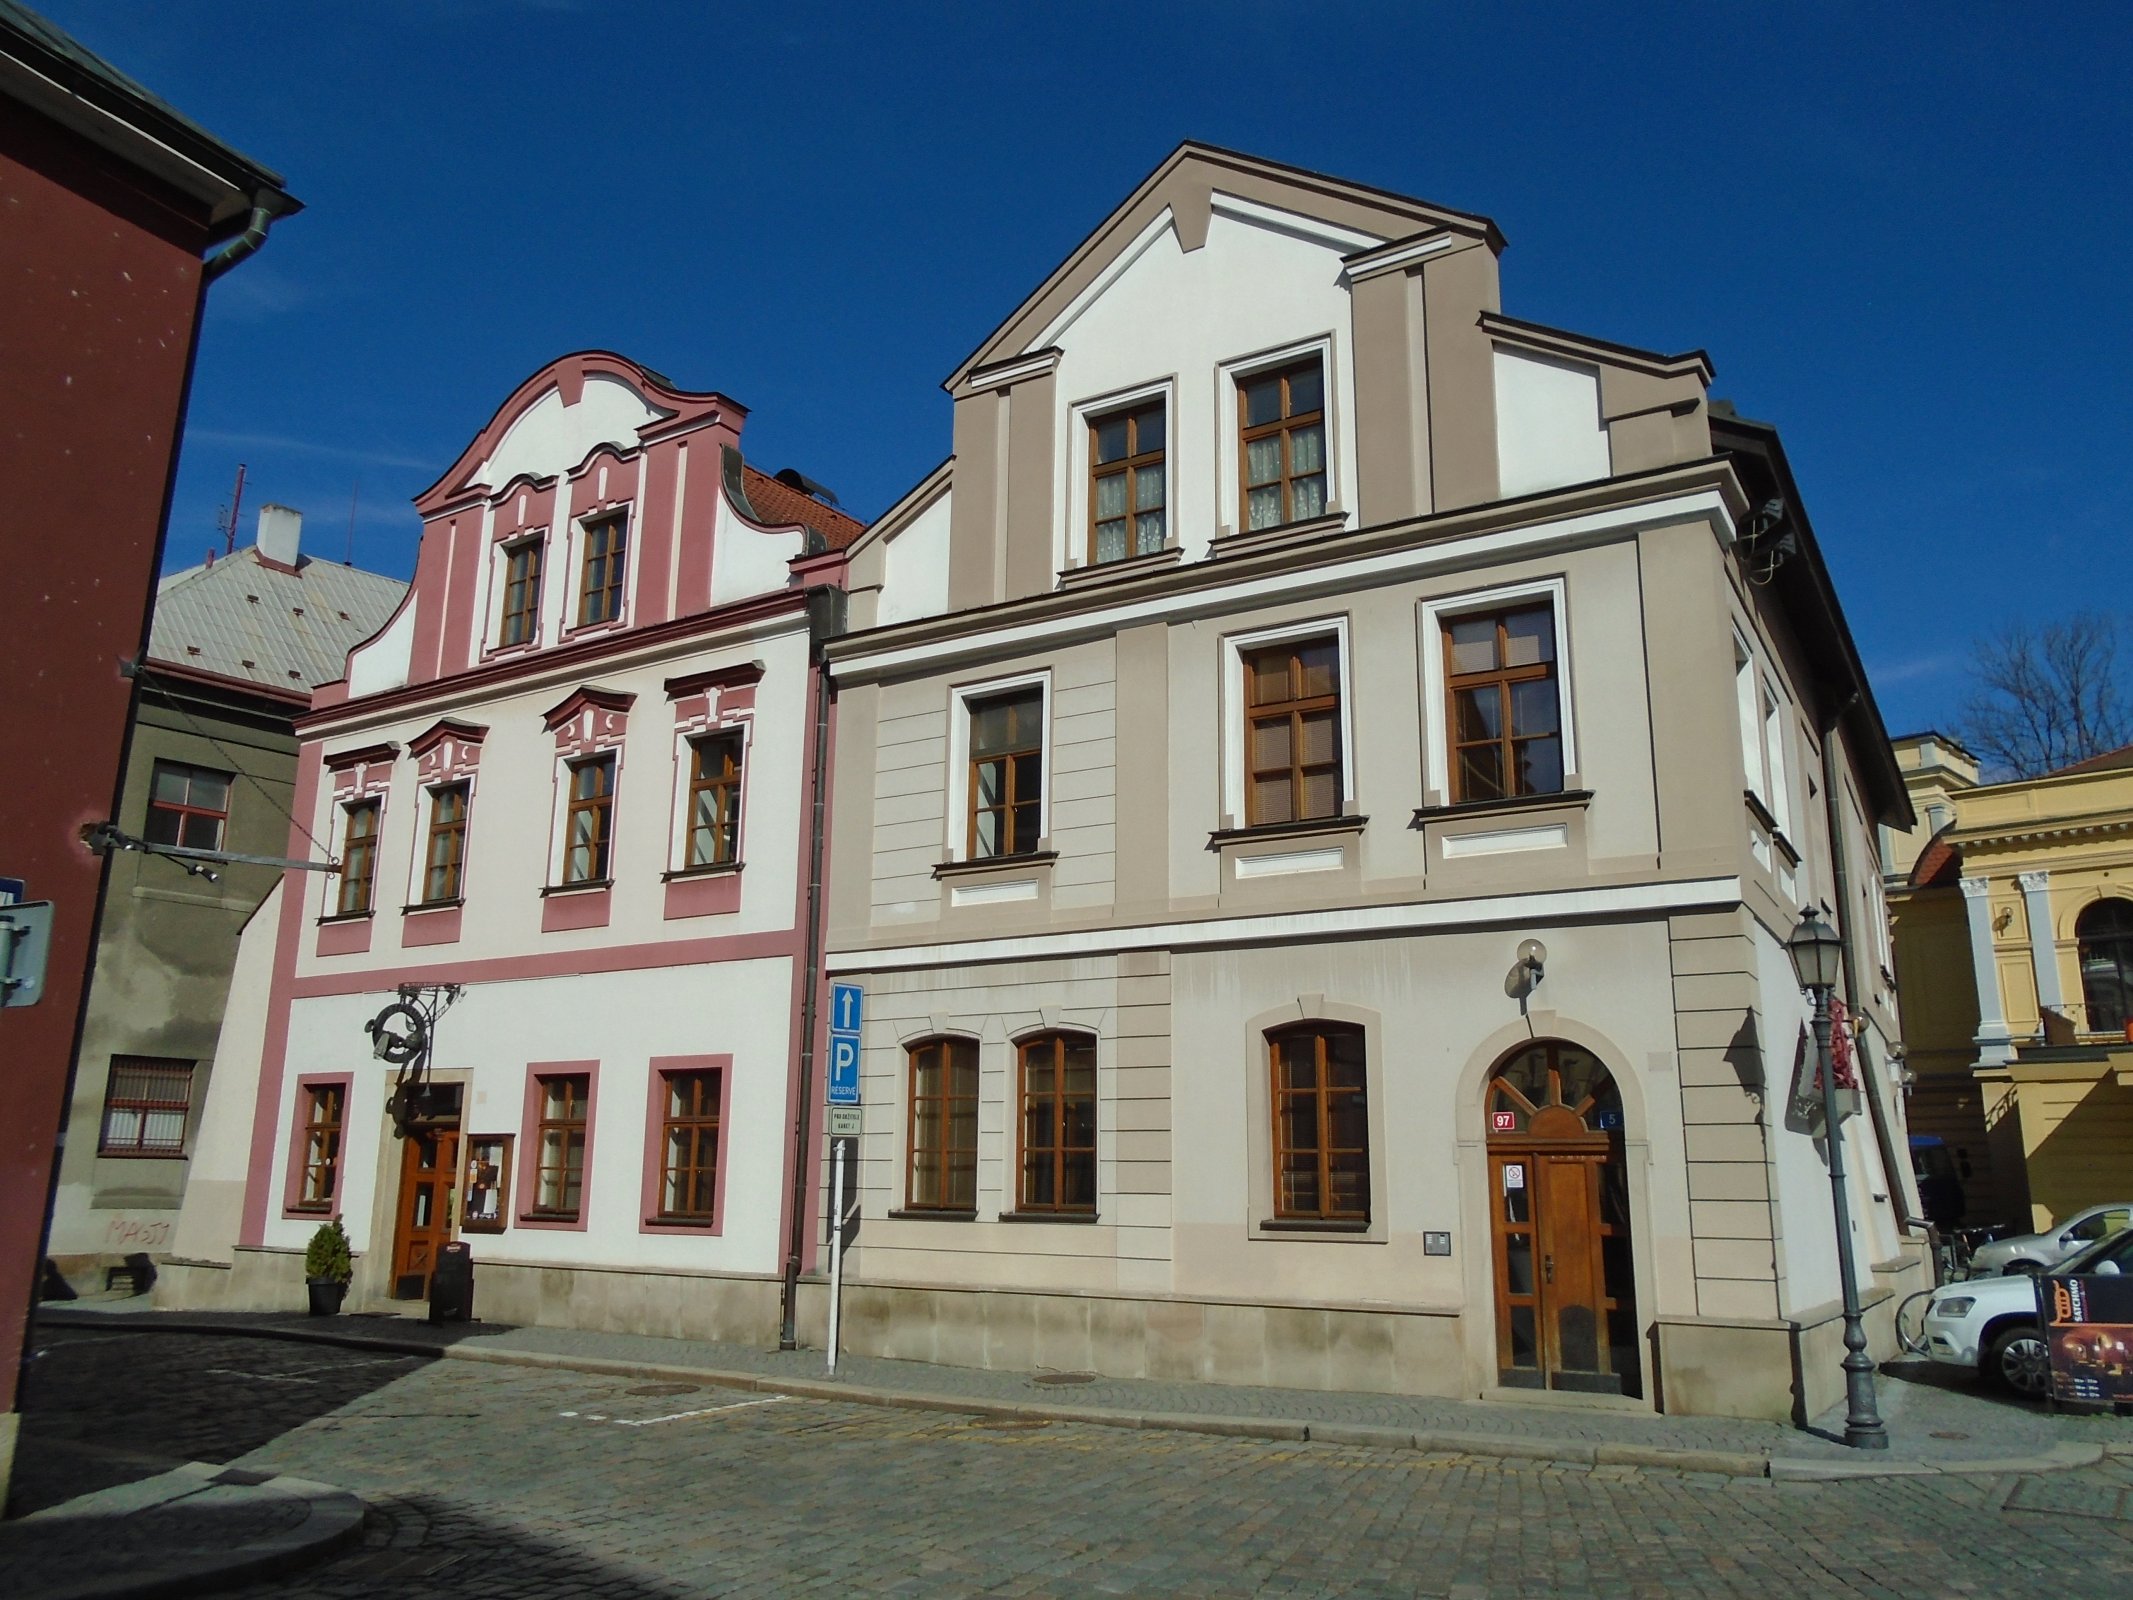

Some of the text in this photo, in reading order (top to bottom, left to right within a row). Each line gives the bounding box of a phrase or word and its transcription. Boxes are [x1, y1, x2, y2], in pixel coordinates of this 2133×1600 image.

[835, 1042, 854, 1081] P
[1496, 1115, 1510, 1127] 97
[1608, 1113, 1616, 1125] 5
[2069, 1279, 2083, 1322] SATCHMO
